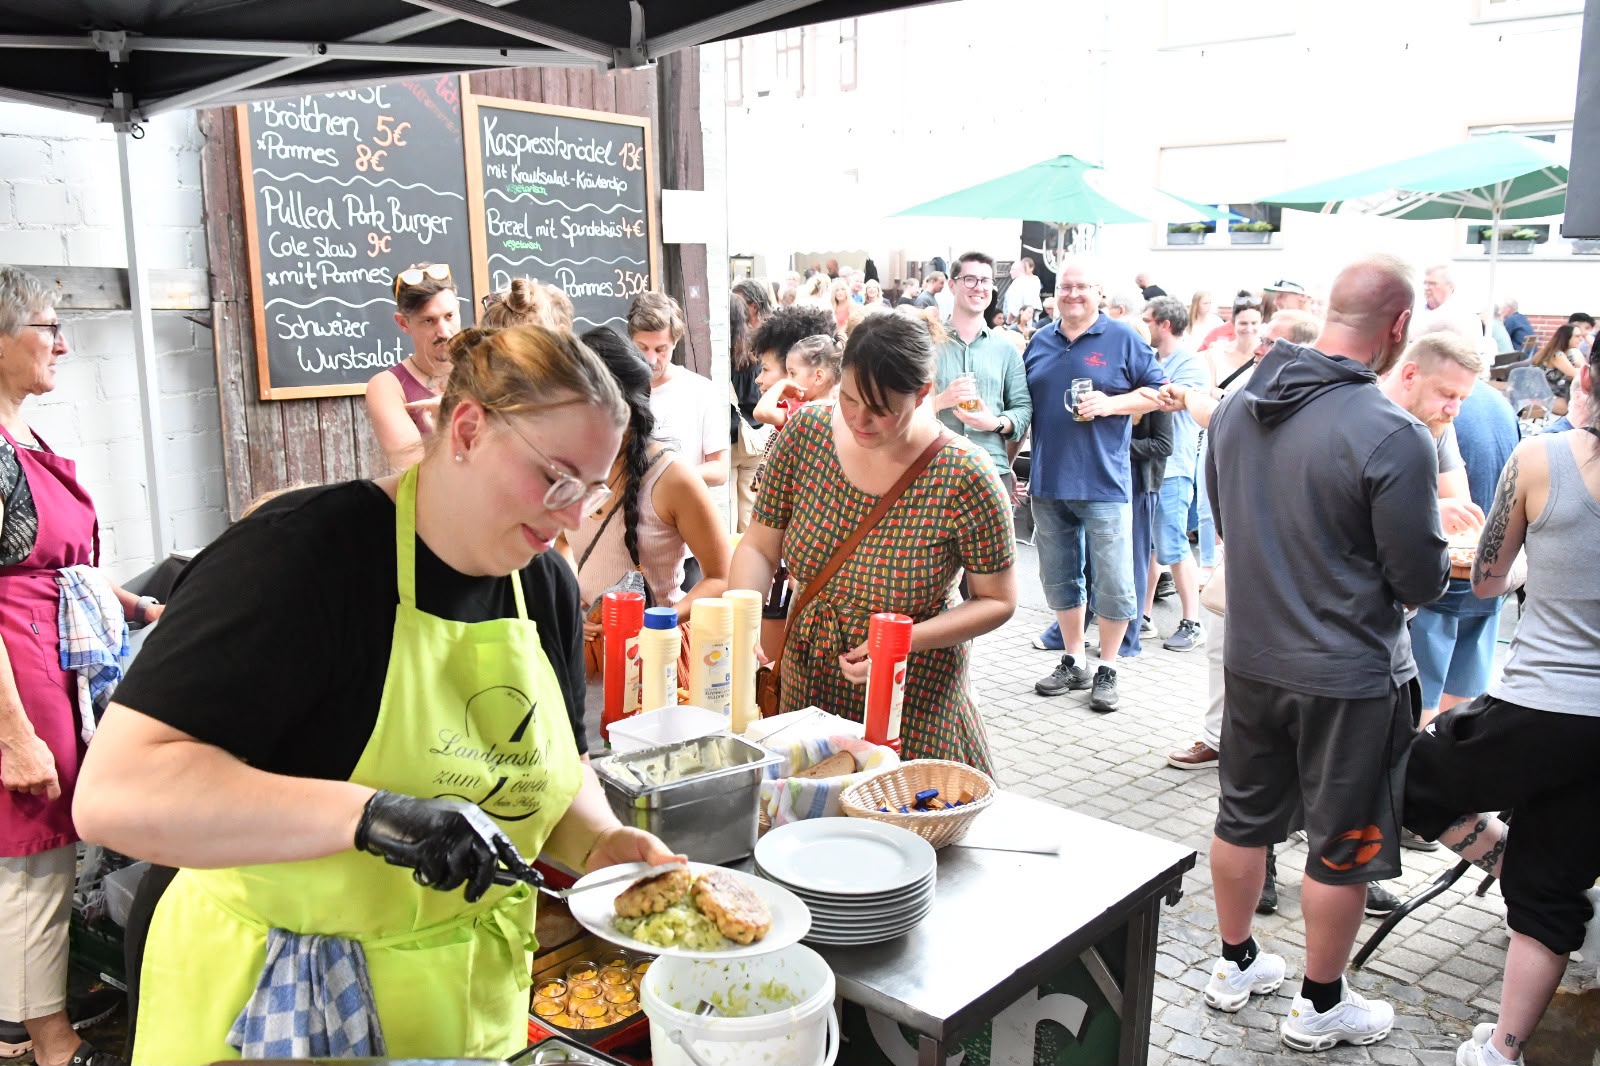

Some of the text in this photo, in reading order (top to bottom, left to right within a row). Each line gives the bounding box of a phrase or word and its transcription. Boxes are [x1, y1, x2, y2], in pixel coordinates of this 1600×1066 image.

[264, 97, 362, 141] Brötchen
[373, 115, 411, 146] 5€
[355, 144, 388, 172] 8€
[483, 116, 643, 171] Kaspressknödel 13€
[486, 164, 507, 179] mit
[260, 186, 452, 244] Pulled Pork Burger
[486, 207, 532, 239] Brezel
[535, 218, 557, 238] mit
[622, 217, 645, 239] 4€
[268, 231, 310, 257] Cole
[313, 236, 357, 258] Slaw
[555, 267, 613, 297] Pommes
[614, 269, 649, 299] 3,50€
[275, 312, 370, 339] Schweizer
[297, 337, 403, 373] Wurstsalat
[433, 770, 482, 789] zum
